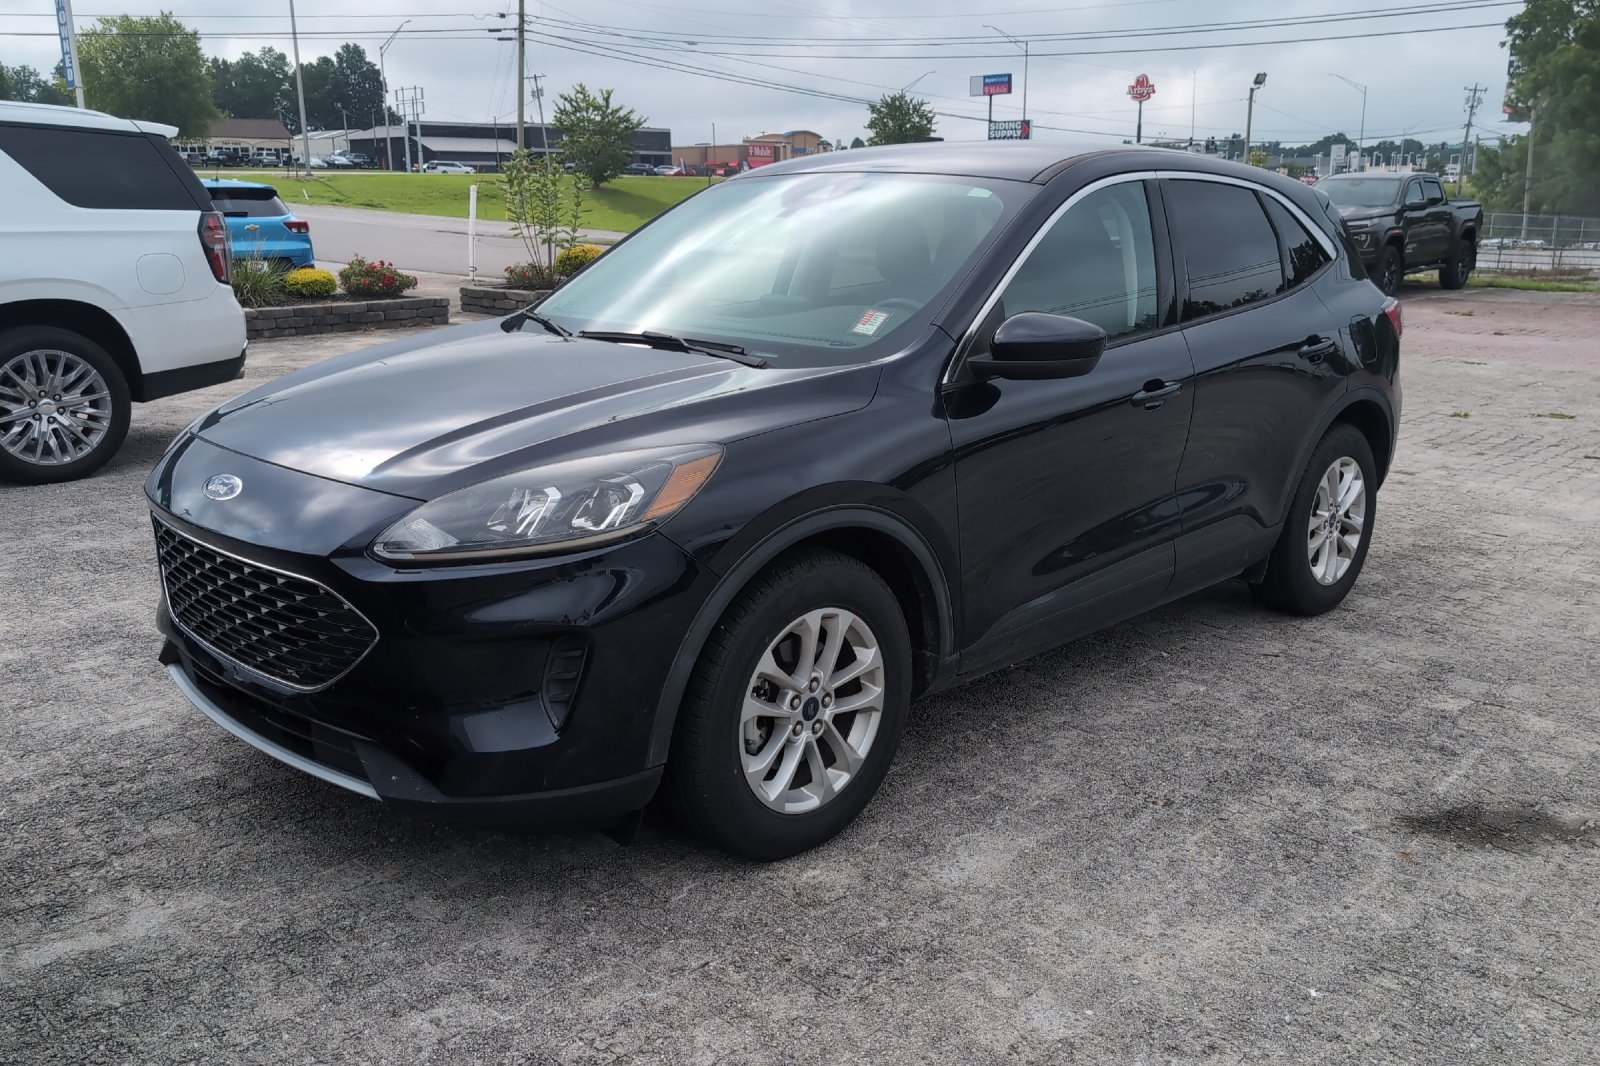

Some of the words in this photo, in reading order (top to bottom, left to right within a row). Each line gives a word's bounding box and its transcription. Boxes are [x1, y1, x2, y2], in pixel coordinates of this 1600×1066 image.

[58, 11, 74, 81] OWNED
[990, 122, 1021, 130] SIDING
[990, 130, 1021, 138] SUPPLY
[208, 477, 232, 494] Ford
